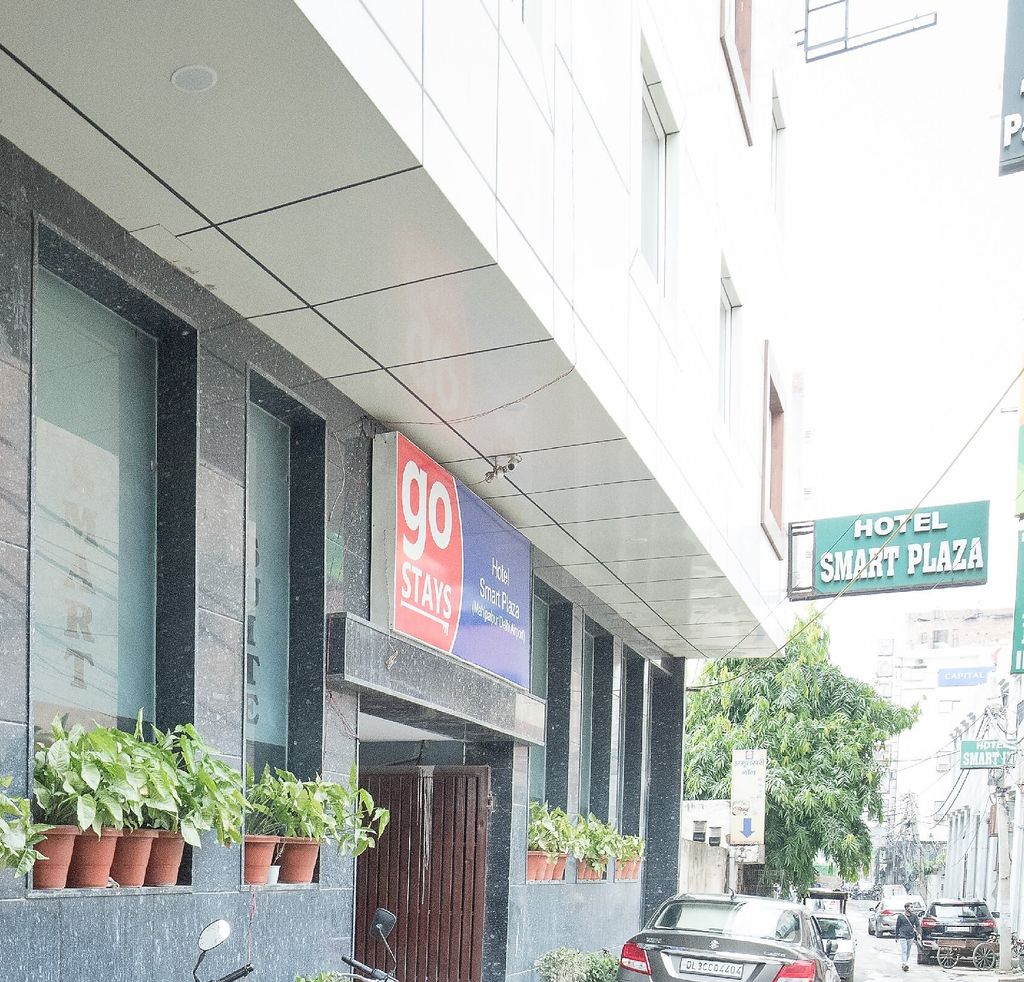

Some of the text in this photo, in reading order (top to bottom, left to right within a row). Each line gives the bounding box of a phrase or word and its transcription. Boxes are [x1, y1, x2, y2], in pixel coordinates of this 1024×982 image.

[402, 460, 453, 561] go
[854, 511, 948, 538] HOTEL
[491, 557, 509, 586] Hotel
[820, 537, 984, 583] SMART PLAZA
[401, 561, 452, 619] STAYS
[480, 577, 520, 619] Smart Plaza
[944, 671, 985, 680] CAPITAL
[963, 751, 999, 766] SMART
